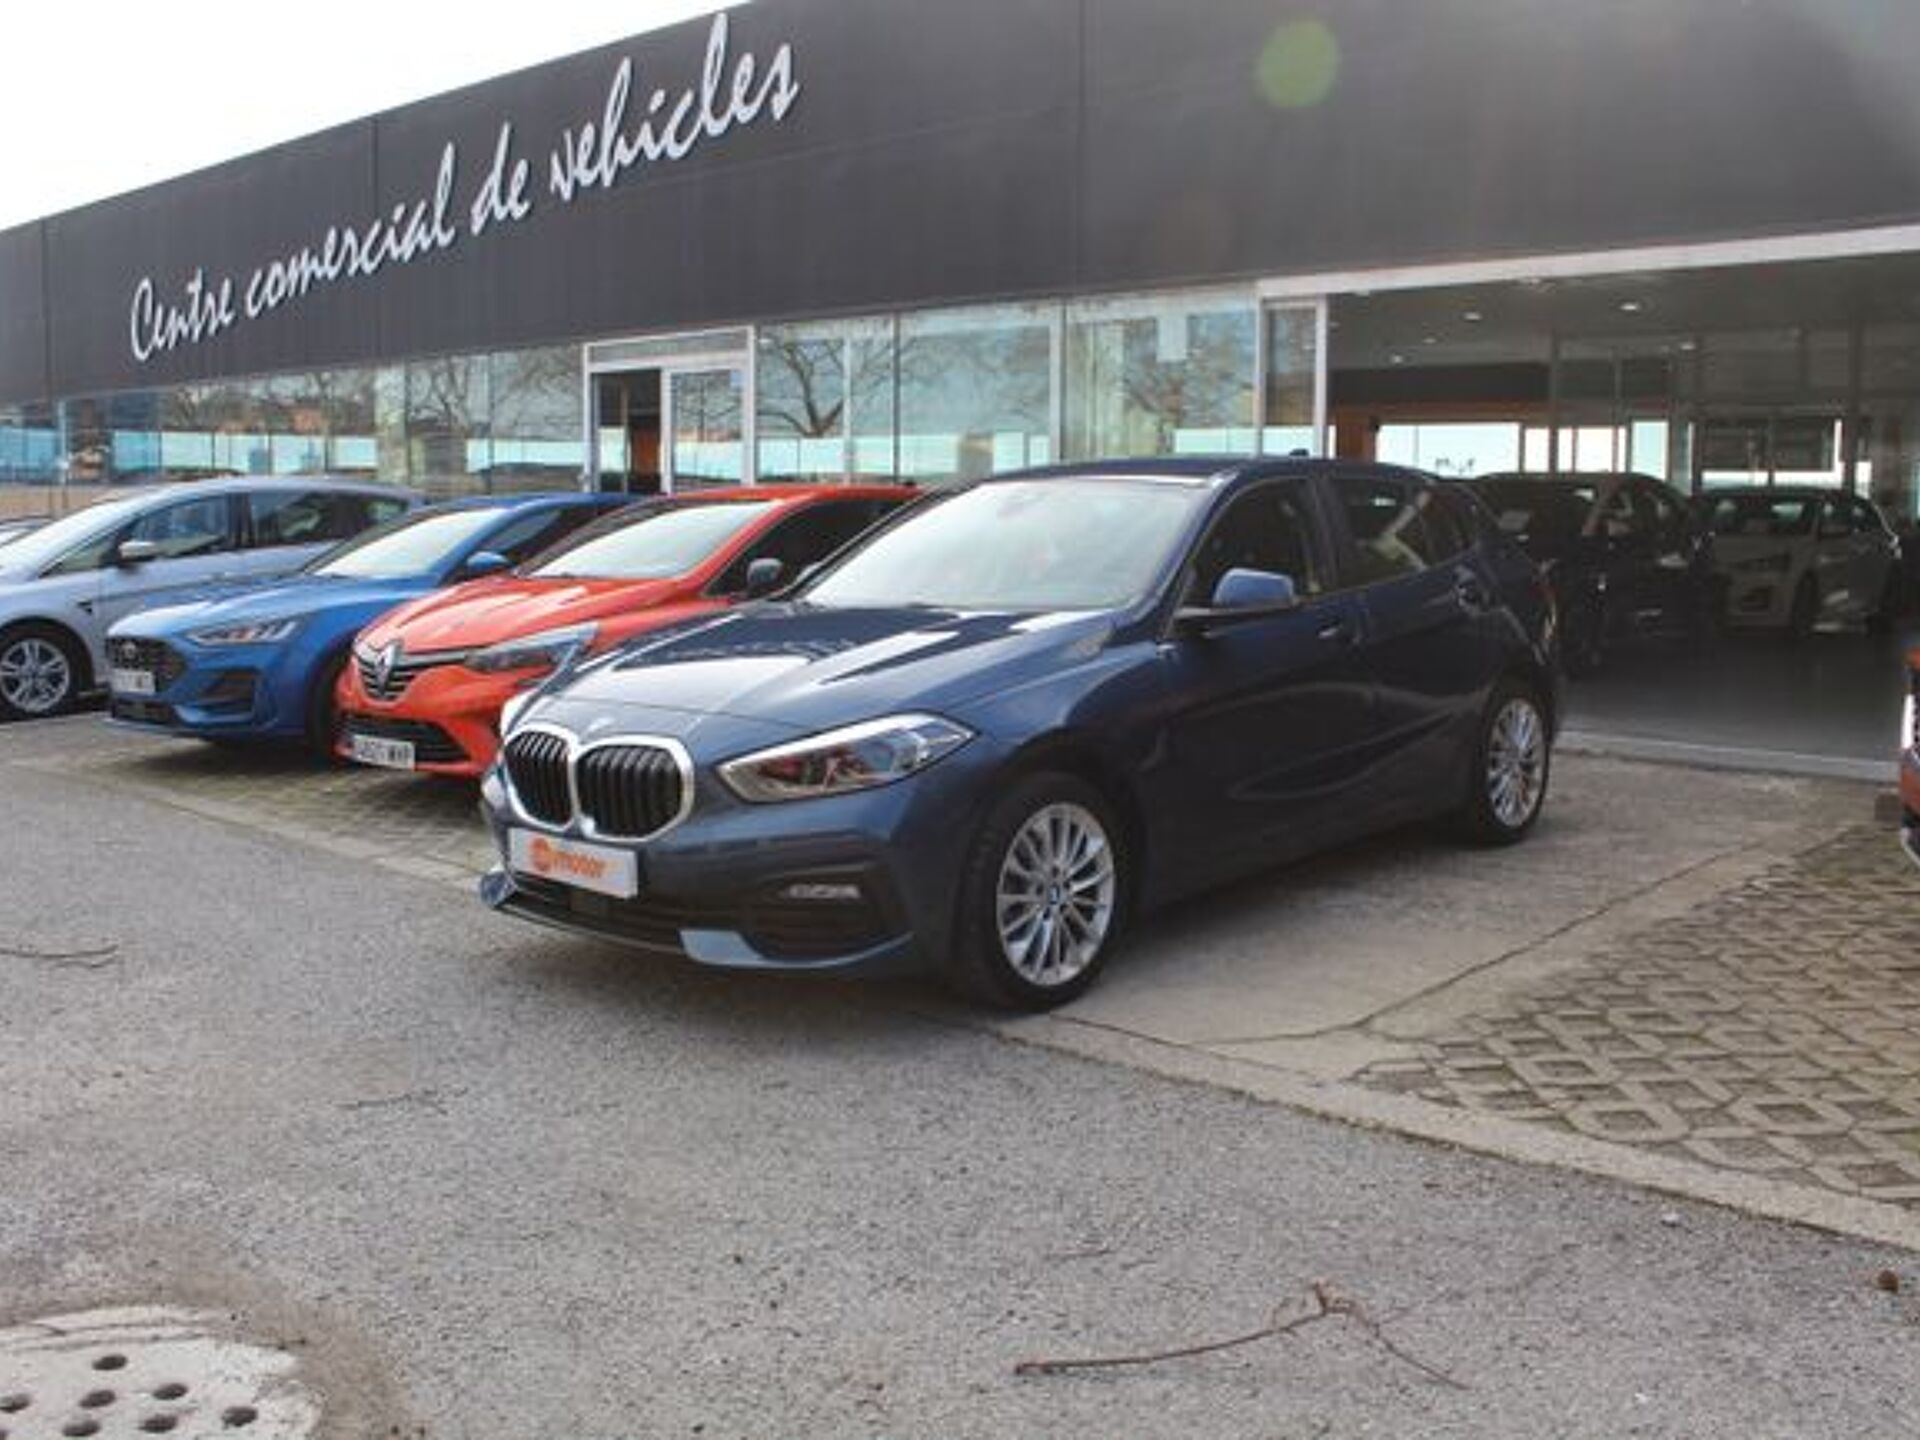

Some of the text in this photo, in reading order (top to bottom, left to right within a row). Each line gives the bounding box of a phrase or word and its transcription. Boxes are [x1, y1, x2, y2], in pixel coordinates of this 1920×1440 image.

[130, 12, 799, 362] Centre comercial de vehicles
